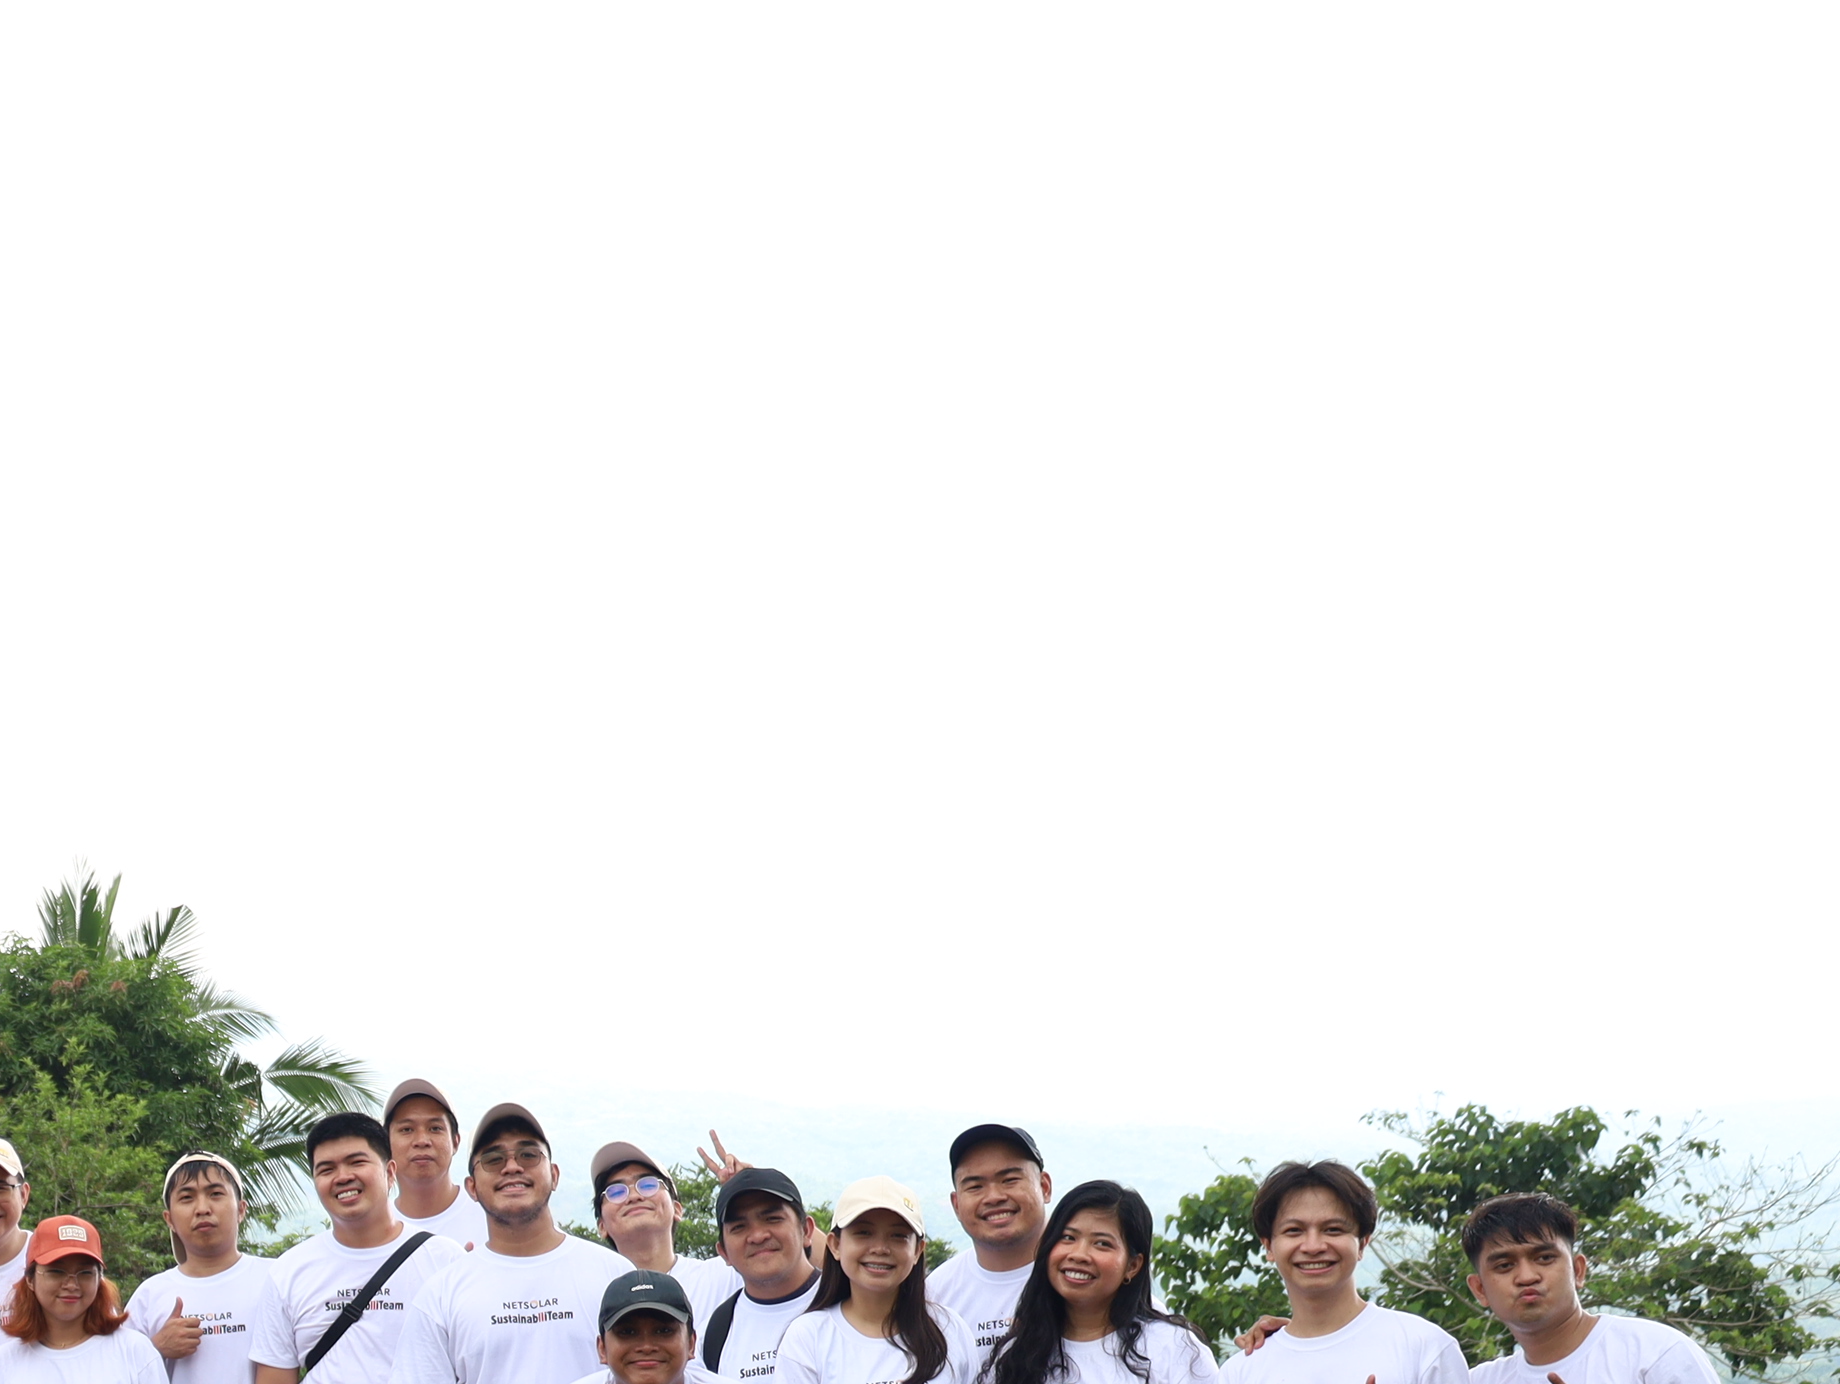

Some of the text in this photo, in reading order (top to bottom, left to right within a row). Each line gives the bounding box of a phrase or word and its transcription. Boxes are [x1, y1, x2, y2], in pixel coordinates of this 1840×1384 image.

[337, 1288, 391, 1298] NETAR
[502, 1298, 558, 1310] NETSOLAR
[978, 1318, 1013, 1331] NETSO
[752, 1350, 778, 1361] NETS
